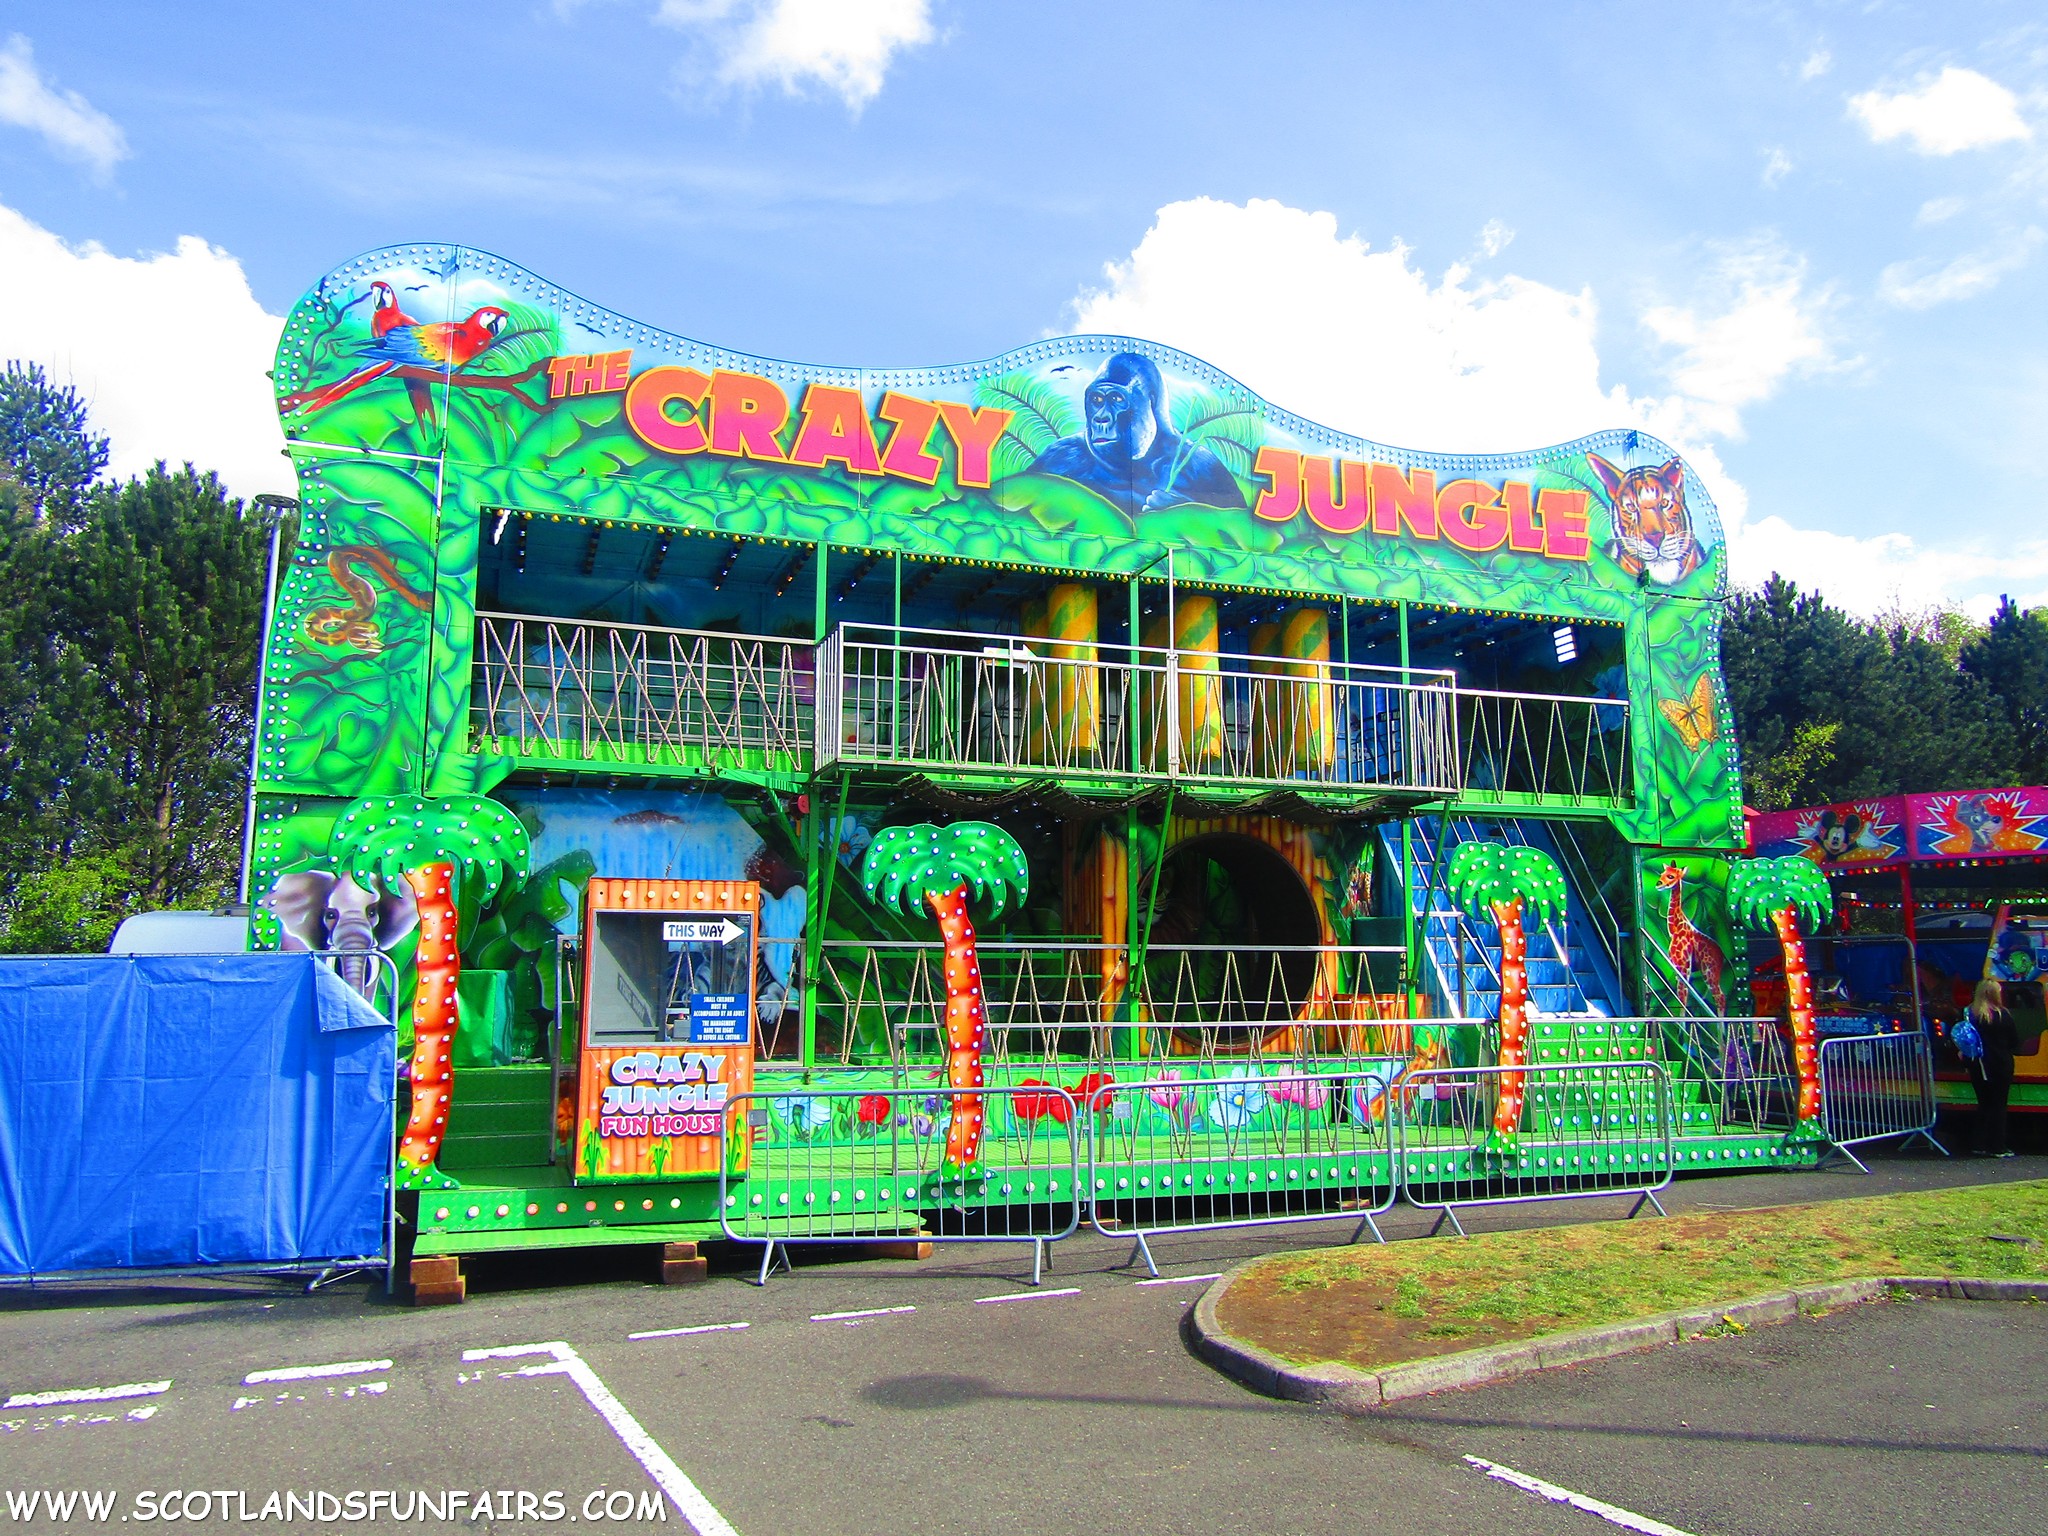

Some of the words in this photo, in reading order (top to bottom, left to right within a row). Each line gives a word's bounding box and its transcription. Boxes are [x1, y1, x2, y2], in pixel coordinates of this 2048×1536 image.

[549, 349, 634, 398] THE
[625, 364, 1015, 489] CRAZY
[1253, 445, 1591, 561] JUNGLE
[668, 924, 695, 937] THIS
[699, 925, 725, 937] WAY
[612, 1052, 727, 1084] CRAZY
[601, 1083, 728, 1114] JUNGLE
[601, 1115, 649, 1137] FUN
[653, 1113, 722, 1135] HOUSE
